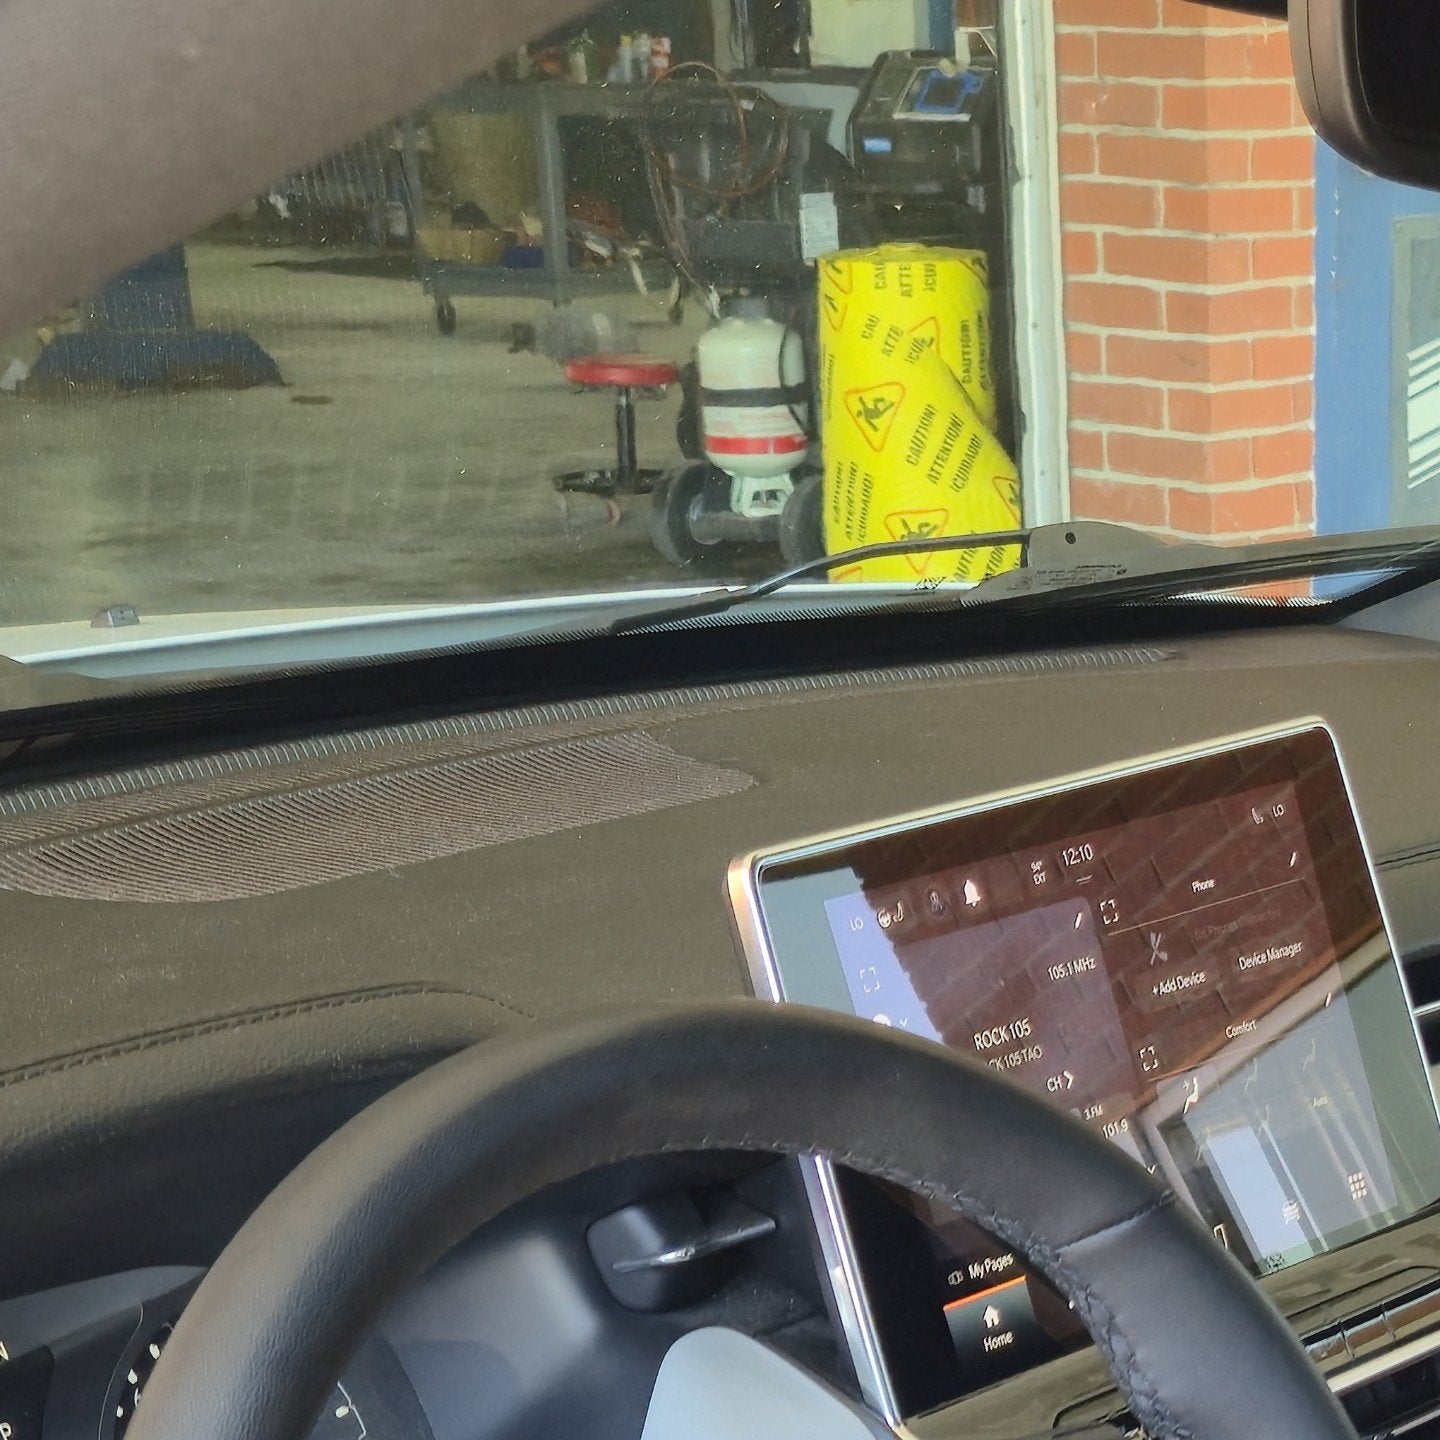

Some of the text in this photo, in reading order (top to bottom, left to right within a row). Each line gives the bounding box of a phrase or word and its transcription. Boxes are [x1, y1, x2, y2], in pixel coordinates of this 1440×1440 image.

[905, 403, 937, 466] CAUTION!
[927, 411, 965, 485] ATTENTION!
[1271, 804, 1285, 818] LO
[1062, 843, 1094, 867] 12:10
[1191, 877, 1216, 894] Phone
[1238, 941, 1303, 972] Device Manager
[1047, 955, 1097, 983] 105.1 MHz
[1176, 970, 1208, 991] Device
[972, 1017, 1032, 1051] ROCK 105
[1226, 1019, 1258, 1040] Comfort
[1003, 1053, 1022, 1069] 105
[1021, 1045, 1043, 1063] TAO
[1046, 1076, 1062, 1093] CH
[1102, 1118, 1130, 1140] 101.9
[968, 1252, 1014, 1280] My Pages
[983, 1331, 1014, 1352] Home
